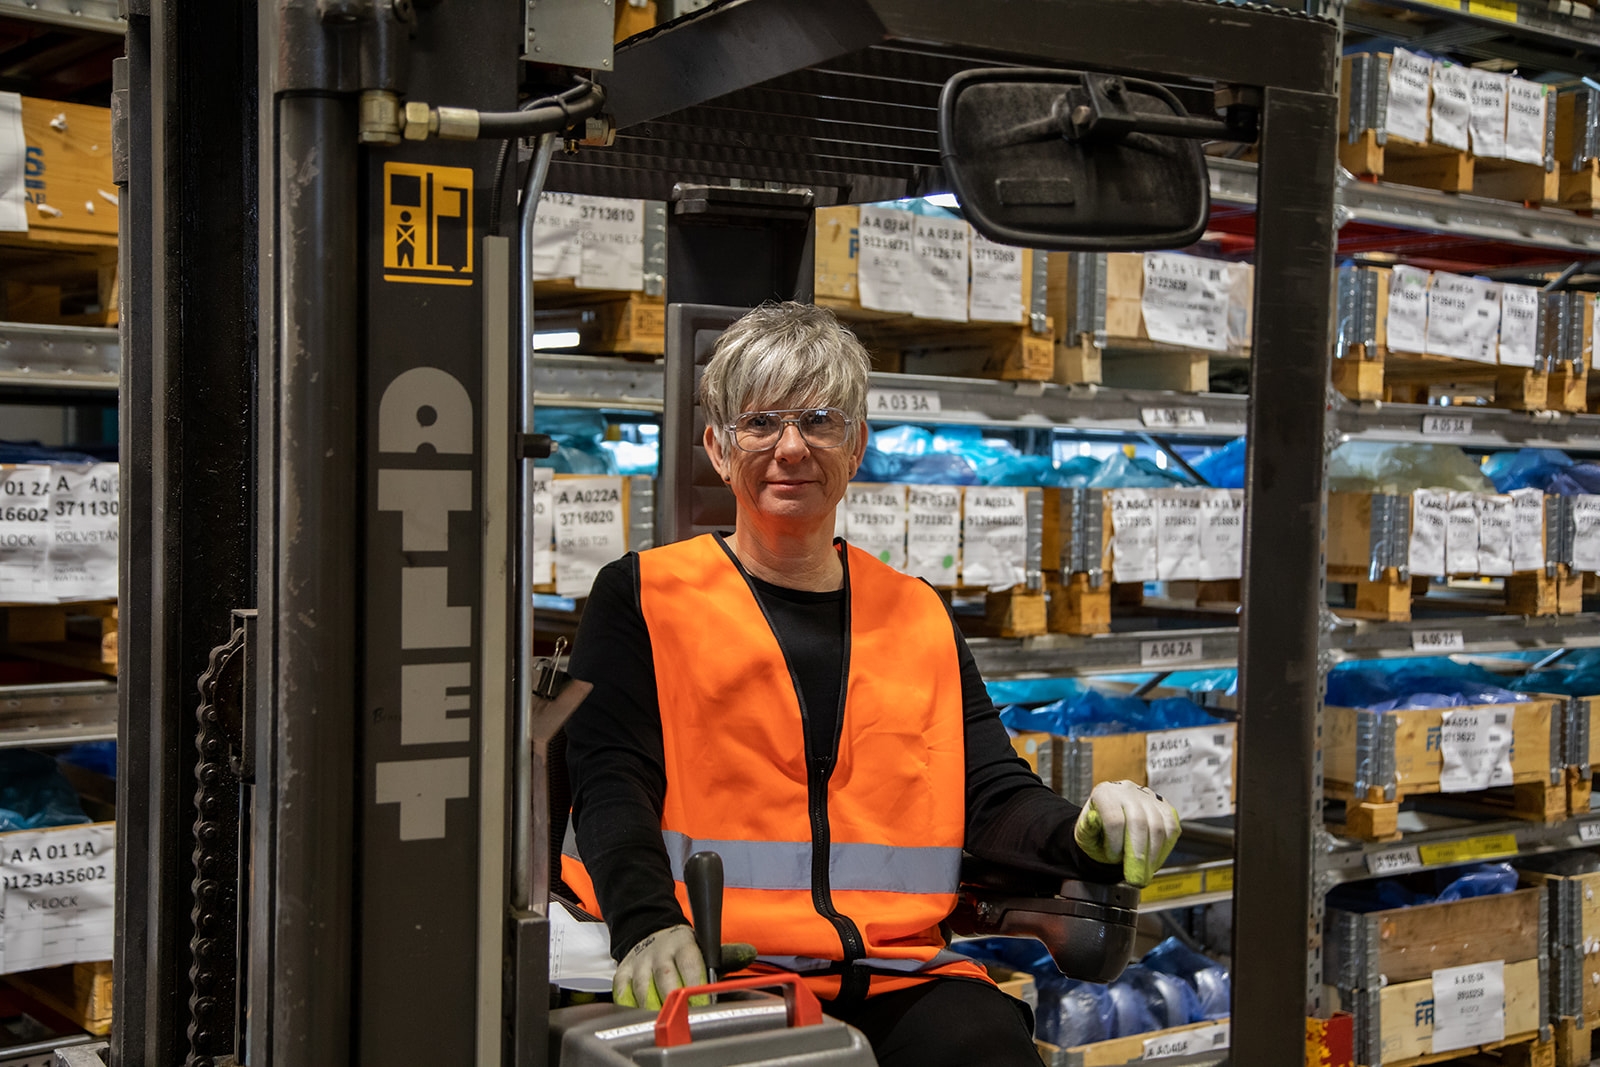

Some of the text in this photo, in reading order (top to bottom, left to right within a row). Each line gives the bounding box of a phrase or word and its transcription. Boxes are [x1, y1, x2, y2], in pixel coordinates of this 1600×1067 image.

[375, 366, 474, 842] ATLET
[11, 848, 23, 863] A
[29, 846, 41, 861] A
